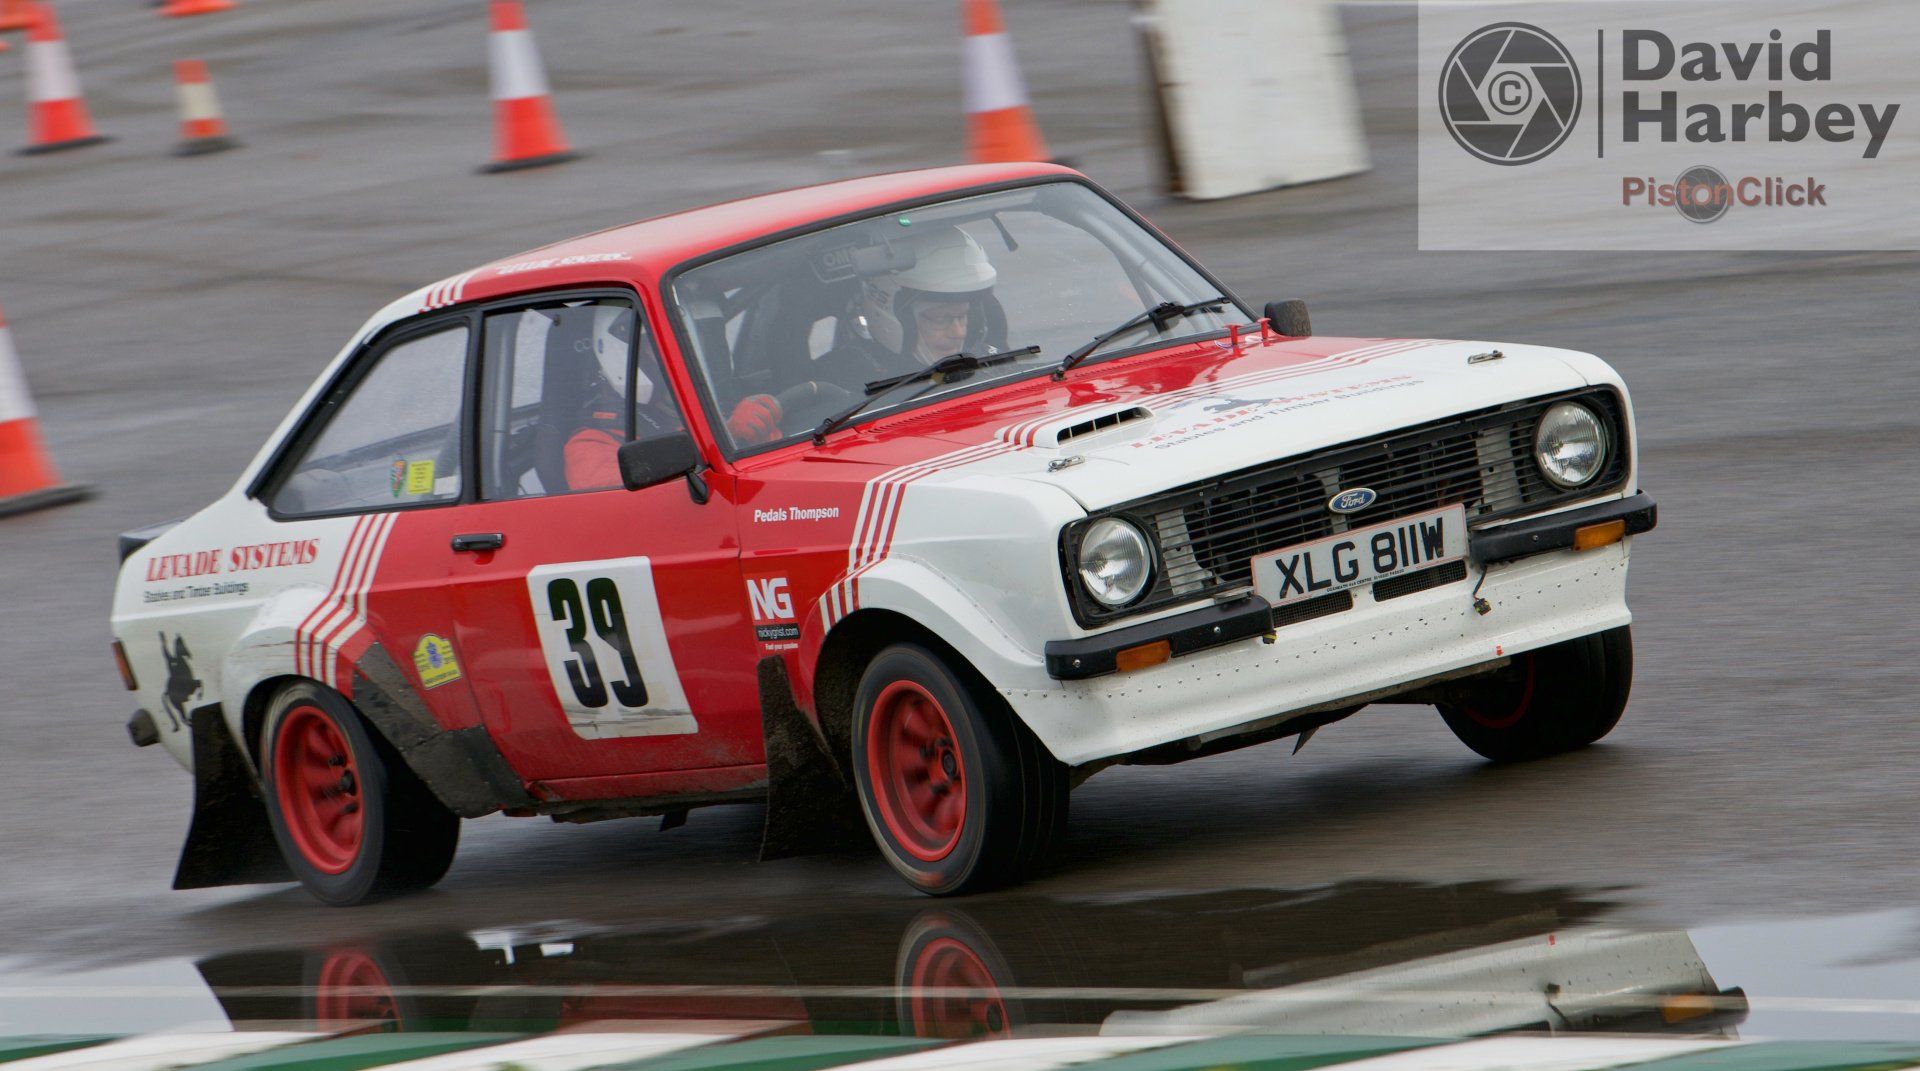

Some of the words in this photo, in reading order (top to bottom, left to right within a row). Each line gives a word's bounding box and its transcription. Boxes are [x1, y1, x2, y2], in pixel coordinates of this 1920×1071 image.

[753, 508, 788, 523] Pedals
[789, 506, 840, 521] Thompson
[1340, 493, 1366, 508] Ford
[145, 549, 222, 582] LEVADE
[228, 538, 320, 573] SYSTEMS
[1275, 541, 1360, 599] XLG
[1370, 517, 1445, 574] 811W
[746, 577, 795, 621] NG
[547, 577, 649, 709] 39
